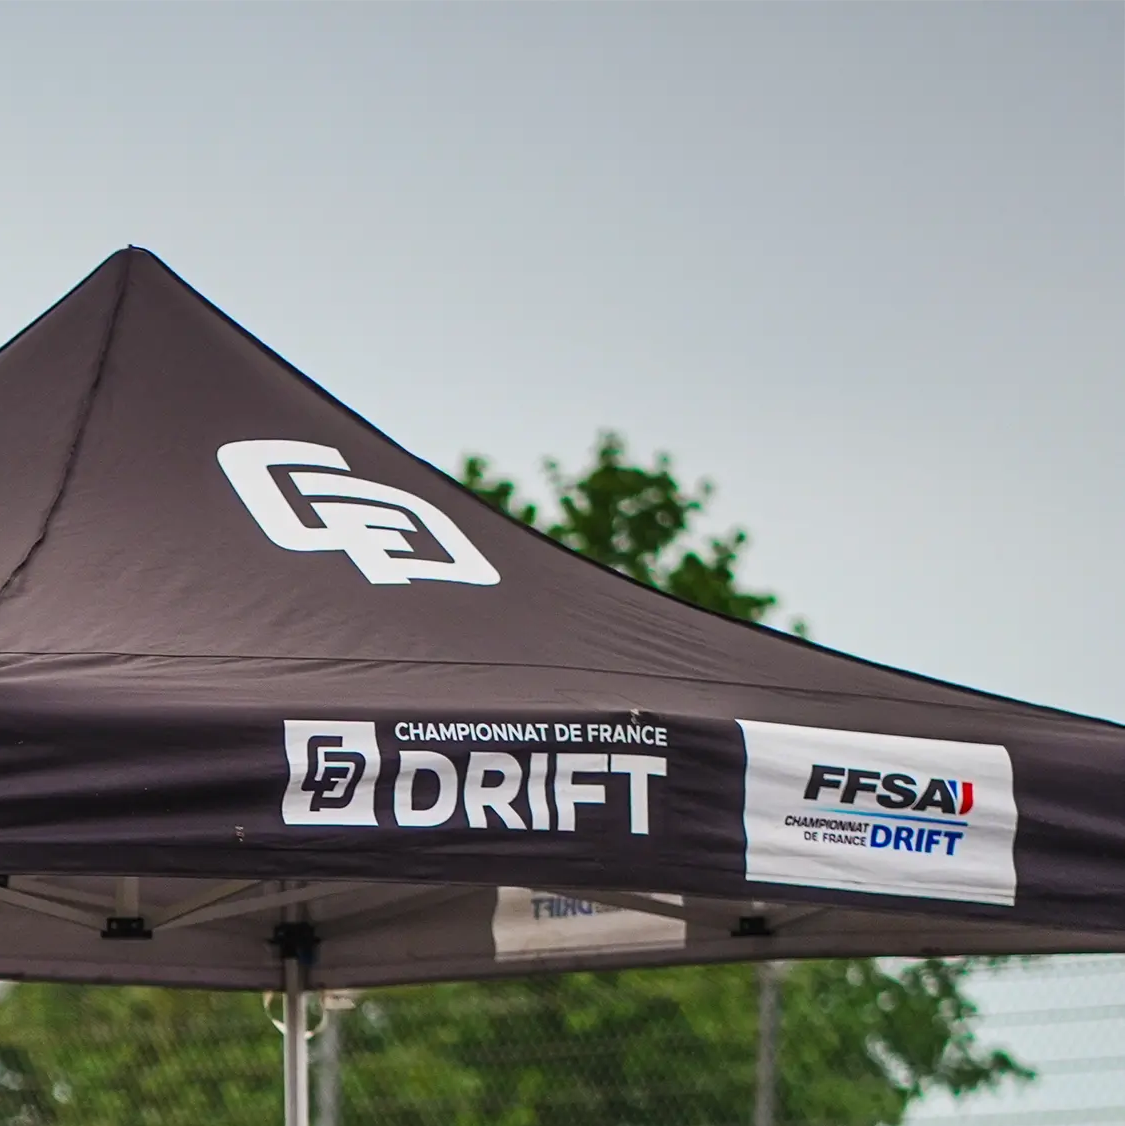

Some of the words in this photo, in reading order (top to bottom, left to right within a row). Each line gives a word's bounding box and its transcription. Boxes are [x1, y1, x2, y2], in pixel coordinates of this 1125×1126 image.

[394, 721, 550, 743] CHAMPIONNAT
[554, 724, 583, 743] DE
[586, 724, 668, 747] FRANCE
[394, 750, 668, 835] DRIFT
[803, 764, 963, 815] FFSA
[784, 814, 870, 834] CHAMPIONNAT
[803, 830, 819, 842] DE
[822, 831, 868, 847] FRANCE
[869, 824, 964, 856] DRIFT
